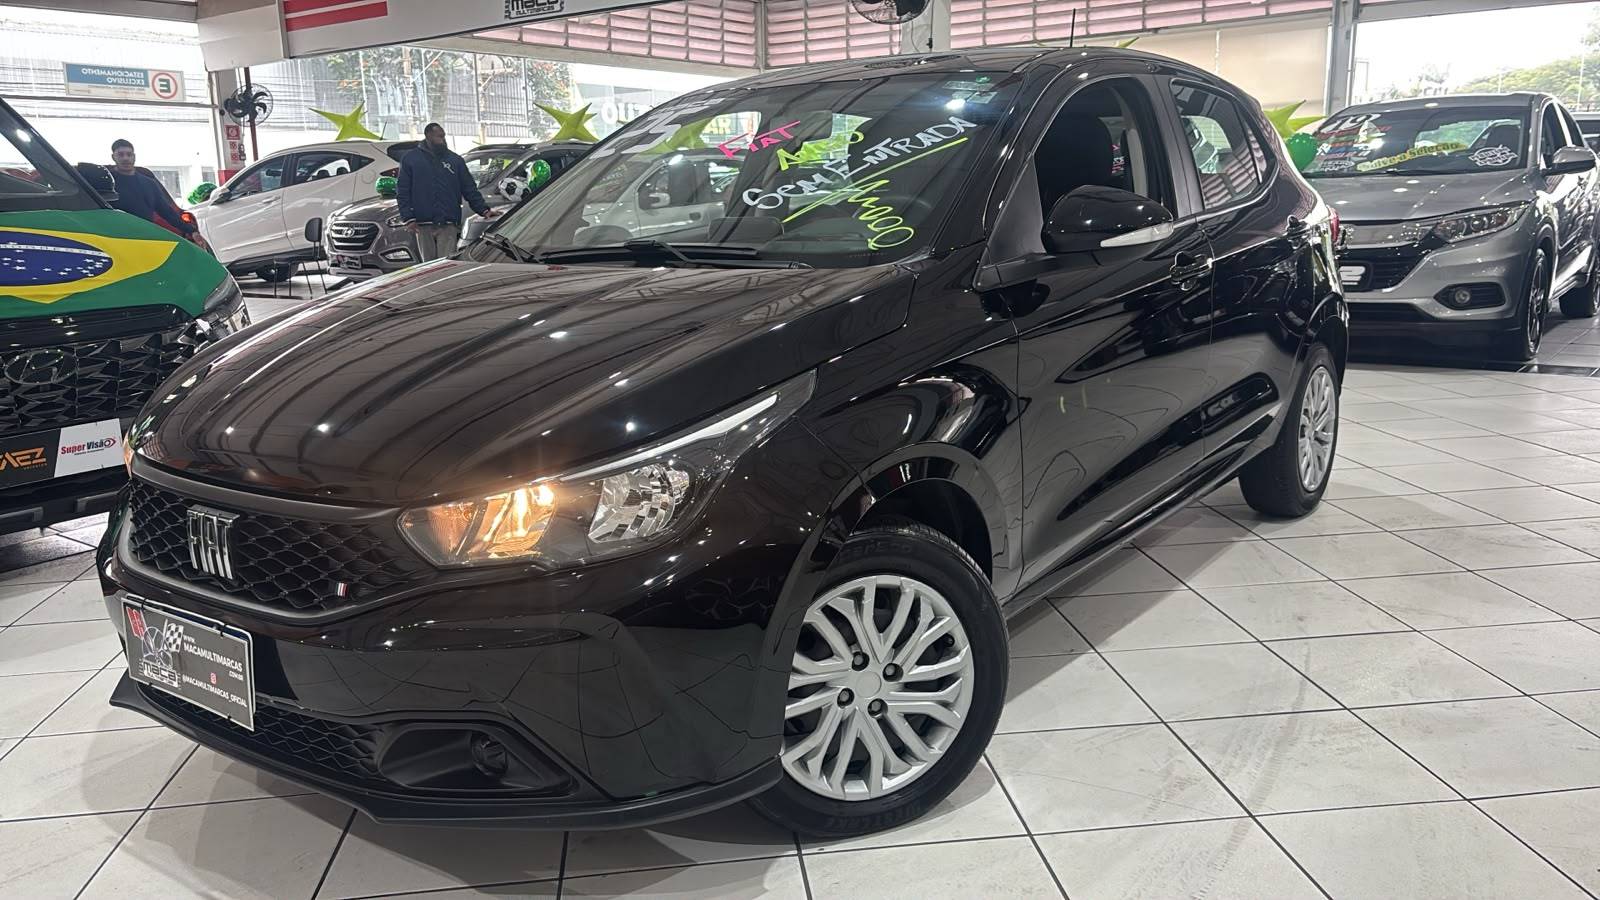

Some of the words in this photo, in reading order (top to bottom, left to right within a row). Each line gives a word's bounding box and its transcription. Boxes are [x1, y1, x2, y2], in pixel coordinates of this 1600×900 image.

[718, 120, 800, 159] FIAT
[61, 443, 86, 455] Super
[187, 507, 238, 580] FIAT
[183, 643, 243, 672] MACAMULTIMARCAS
